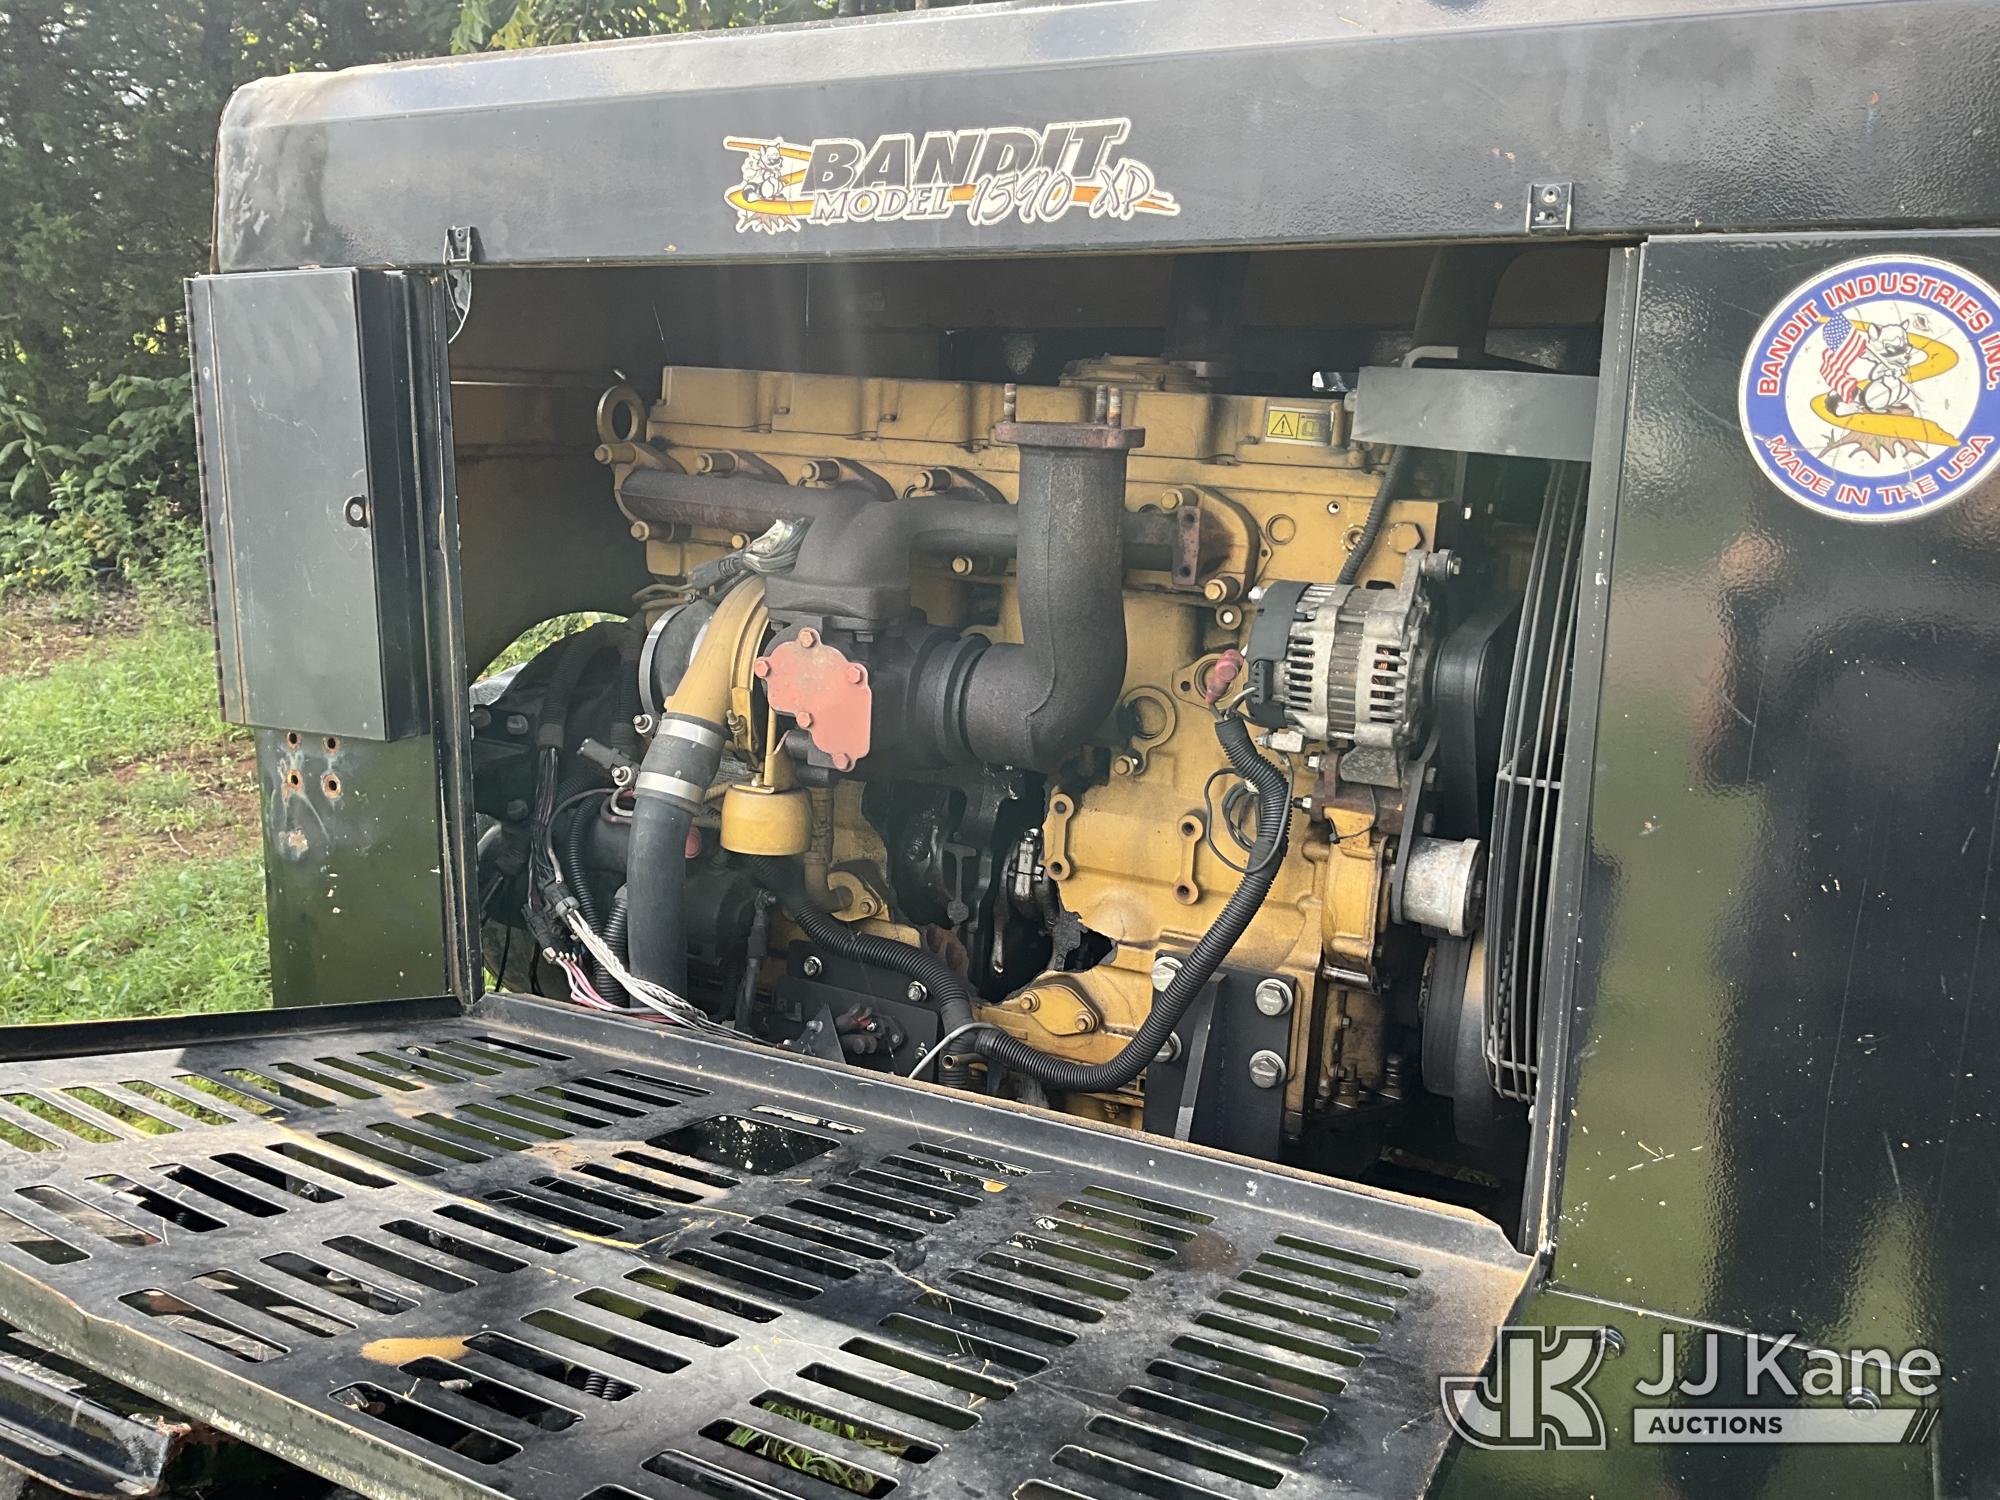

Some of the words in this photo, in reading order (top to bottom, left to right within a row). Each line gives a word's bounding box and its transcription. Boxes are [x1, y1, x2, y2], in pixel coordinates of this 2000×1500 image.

[803, 120, 1127, 192] BANDIT
[812, 187, 950, 219] MODEL
[969, 175, 1072, 223] 1590
[1091, 160, 1151, 217] XP
[1758, 302, 1820, 396] BANDIT
[1824, 273, 1991, 332] INDUSTRIES
[1768, 436, 1834, 496] MADE
[1837, 485, 1870, 506] IN
[1877, 475, 1938, 505] THE
[1939, 434, 1994, 482] USA
